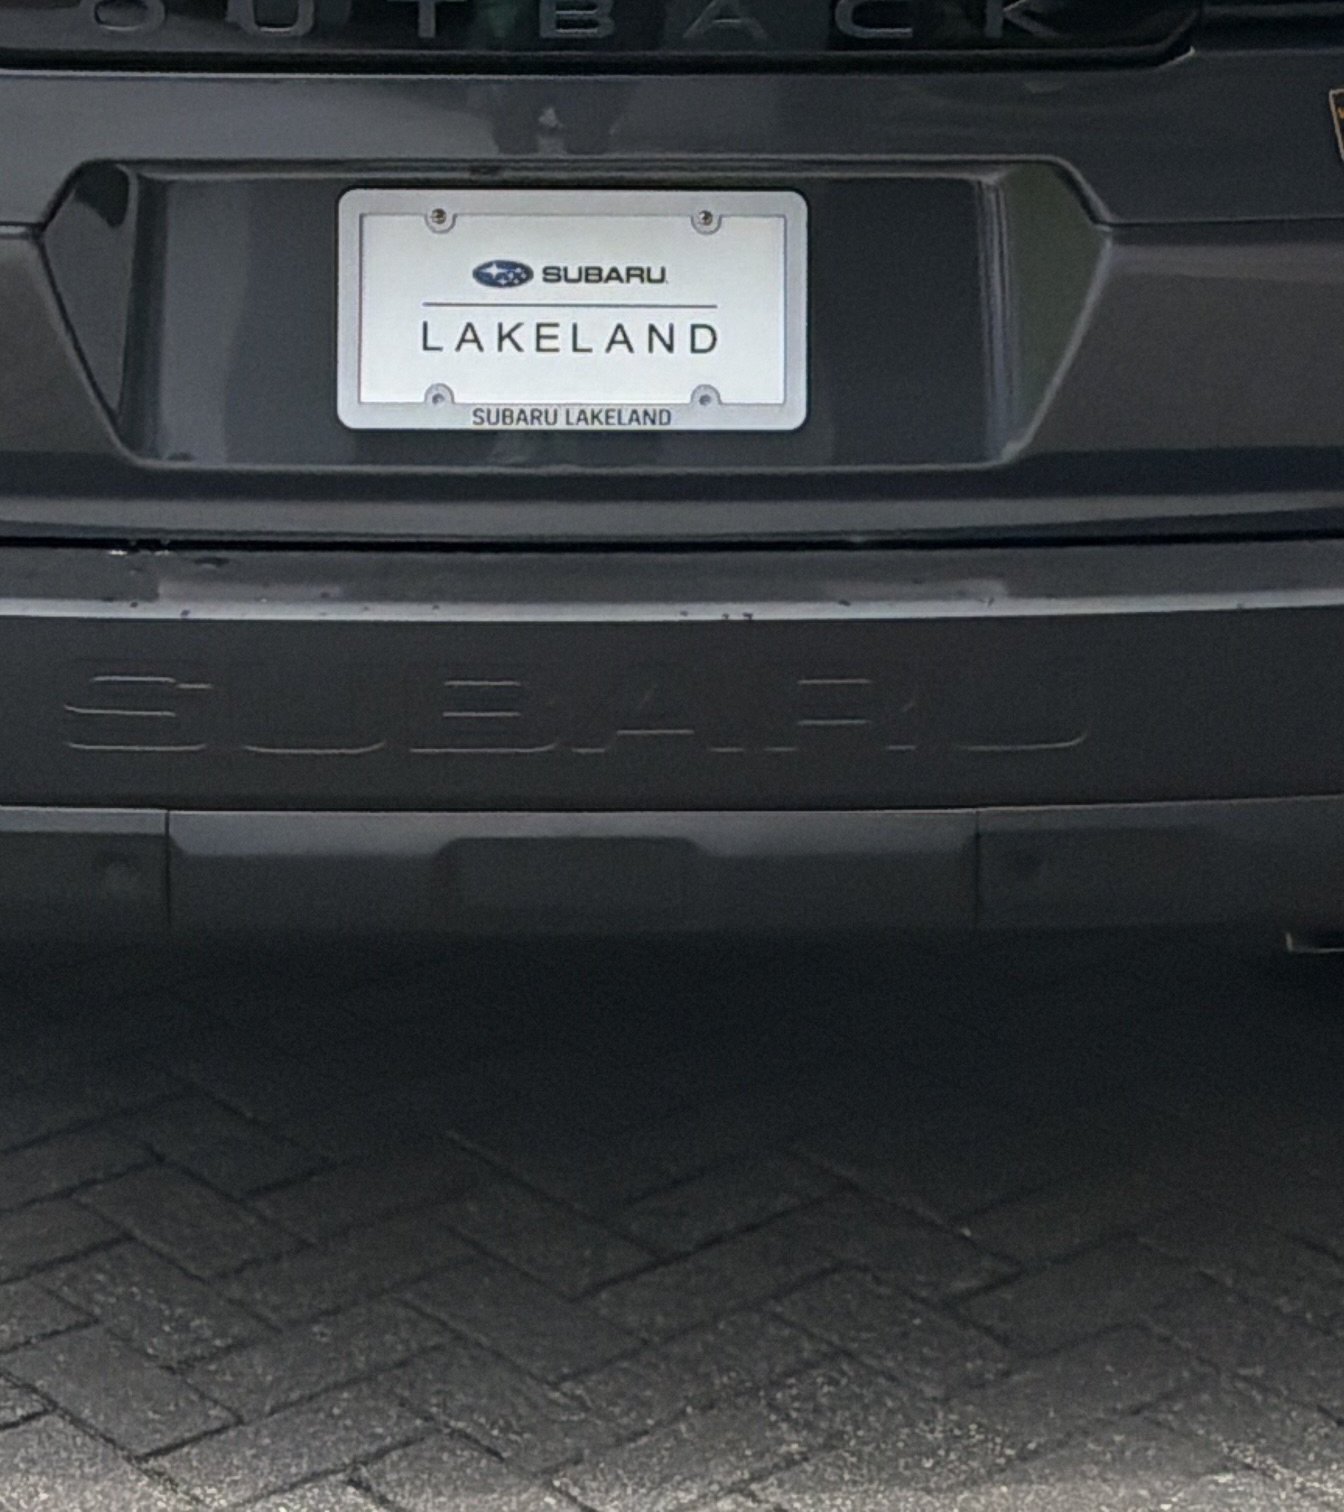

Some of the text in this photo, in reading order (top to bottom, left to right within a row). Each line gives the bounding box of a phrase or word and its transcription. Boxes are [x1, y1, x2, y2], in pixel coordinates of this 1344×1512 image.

[542, 265, 668, 284] SUBARU
[422, 321, 718, 354] LAKELAND
[472, 407, 671, 427] SUBARU LAKELAND
[63, 672, 1088, 755] SUBARU
